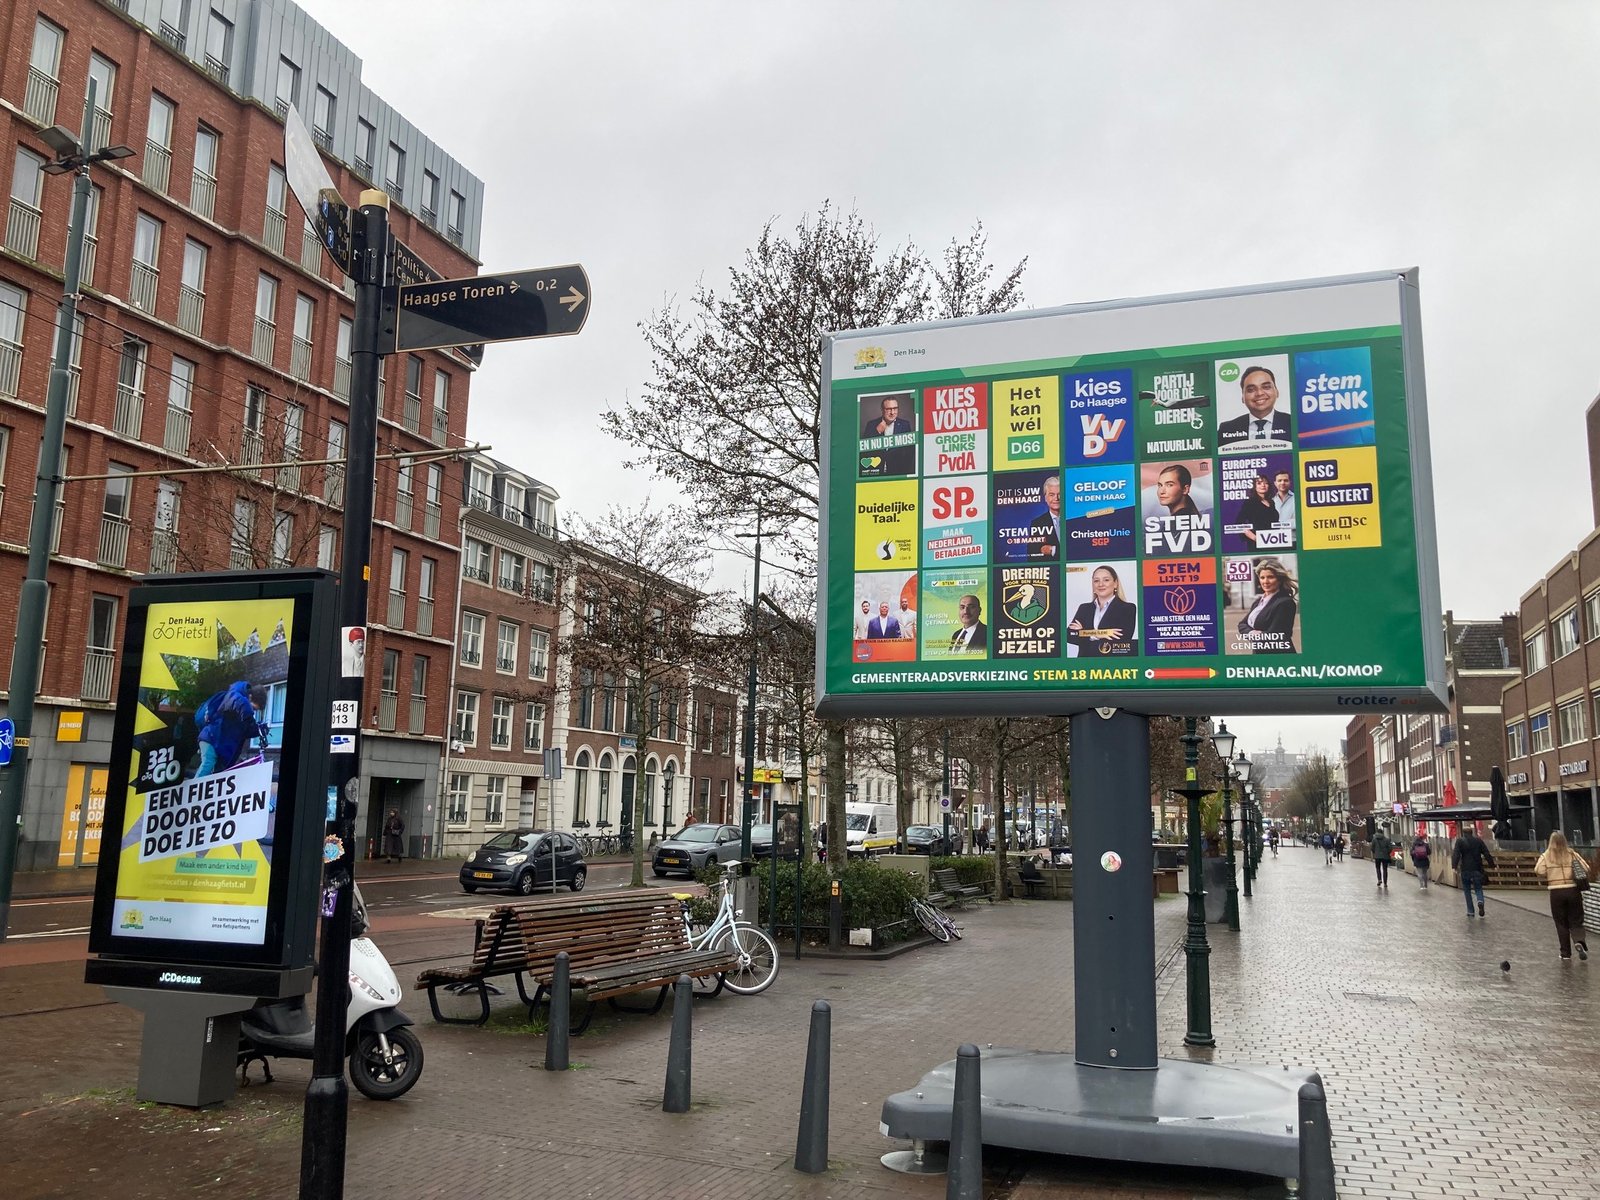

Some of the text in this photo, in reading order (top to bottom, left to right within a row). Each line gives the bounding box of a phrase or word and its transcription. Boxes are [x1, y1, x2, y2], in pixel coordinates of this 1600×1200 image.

[398, 249, 424, 279] Politie
[404, 278, 557, 307] Haagse Toren 0,2
[1075, 378, 1121, 398] kies
[1154, 373, 1195, 391] PARTIJ
[1306, 373, 1362, 393] stem
[936, 387, 976, 410] KIES
[1010, 387, 1041, 401] Het
[1155, 387, 1195, 401] VOOR DE
[1070, 397, 1127, 409] De Haagse
[1302, 390, 1368, 414] DENK
[1011, 404, 1041, 417] kan
[1155, 408, 1195, 425] DIEREN
[932, 408, 979, 431] VOOR
[1010, 417, 1041, 432] wél
[860, 433, 916, 451] EN NU DE MOS!
[936, 434, 976, 445] GROEN
[1080, 413, 1126, 458] VVD
[942, 442, 976, 452] LINKS
[1011, 441, 1040, 454] D66
[1147, 438, 1205, 454] NATUURLIJK.
[938, 452, 976, 472] PvdA
[1223, 458, 1267, 470] EUROPEES
[1223, 469, 1260, 480] DENKEN.
[1309, 465, 1334, 478] NSC
[1074, 480, 1127, 492] GELOOF
[1223, 480, 1254, 490] HAAGS
[998, 488, 1040, 498] DIT IS UW
[1223, 490, 1250, 501] DOEN.
[1310, 488, 1370, 504] LUISTERT
[932, 487, 978, 520] SP.
[1015, 496, 1041, 504] HAAG!
[858, 502, 915, 514] Duidelijke
[872, 513, 900, 523] Taal.
[1145, 514, 1210, 532] STEM
[1313, 519, 1337, 529] STEM
[943, 528, 965, 538] MAAK
[999, 526, 1054, 538] STEM PVV
[1071, 528, 1131, 539] ChristenUnie
[1260, 533, 1288, 544] Volt
[928, 536, 972, 550] NEDERLAND
[1092, 538, 1110, 546] SGP
[1145, 530, 1212, 554] FVD
[935, 546, 981, 559] BETAALBAAR
[1002, 567, 1051, 582] DRERRIE
[1157, 563, 1200, 574] STEM
[1229, 563, 1248, 574] 50
[1160, 575, 1187, 583] LIJST
[169, 617, 205, 626] Den Haag
[176, 626, 212, 639] Fietst!
[998, 628, 1055, 639] STEM OP
[1236, 633, 1285, 641] VERBINDT
[998, 640, 1056, 654] JEZELF
[1231, 642, 1290, 650] GENERATIES
[852, 665, 1383, 684] GEMEENTERAADSVERKIEZING STEM 18 MAART DENHAAG.NL/KOMOP
[1338, 696, 1397, 705] trotter
[148, 746, 175, 771] 321
[152, 760, 181, 785] GO
[149, 775, 236, 812] EEN FIETS
[146, 791, 266, 834] DOORGEVEN
[144, 820, 236, 857] DOE JE ZO
[160, 916, 172, 924] Haag
[160, 972, 202, 984] JCDecaux
